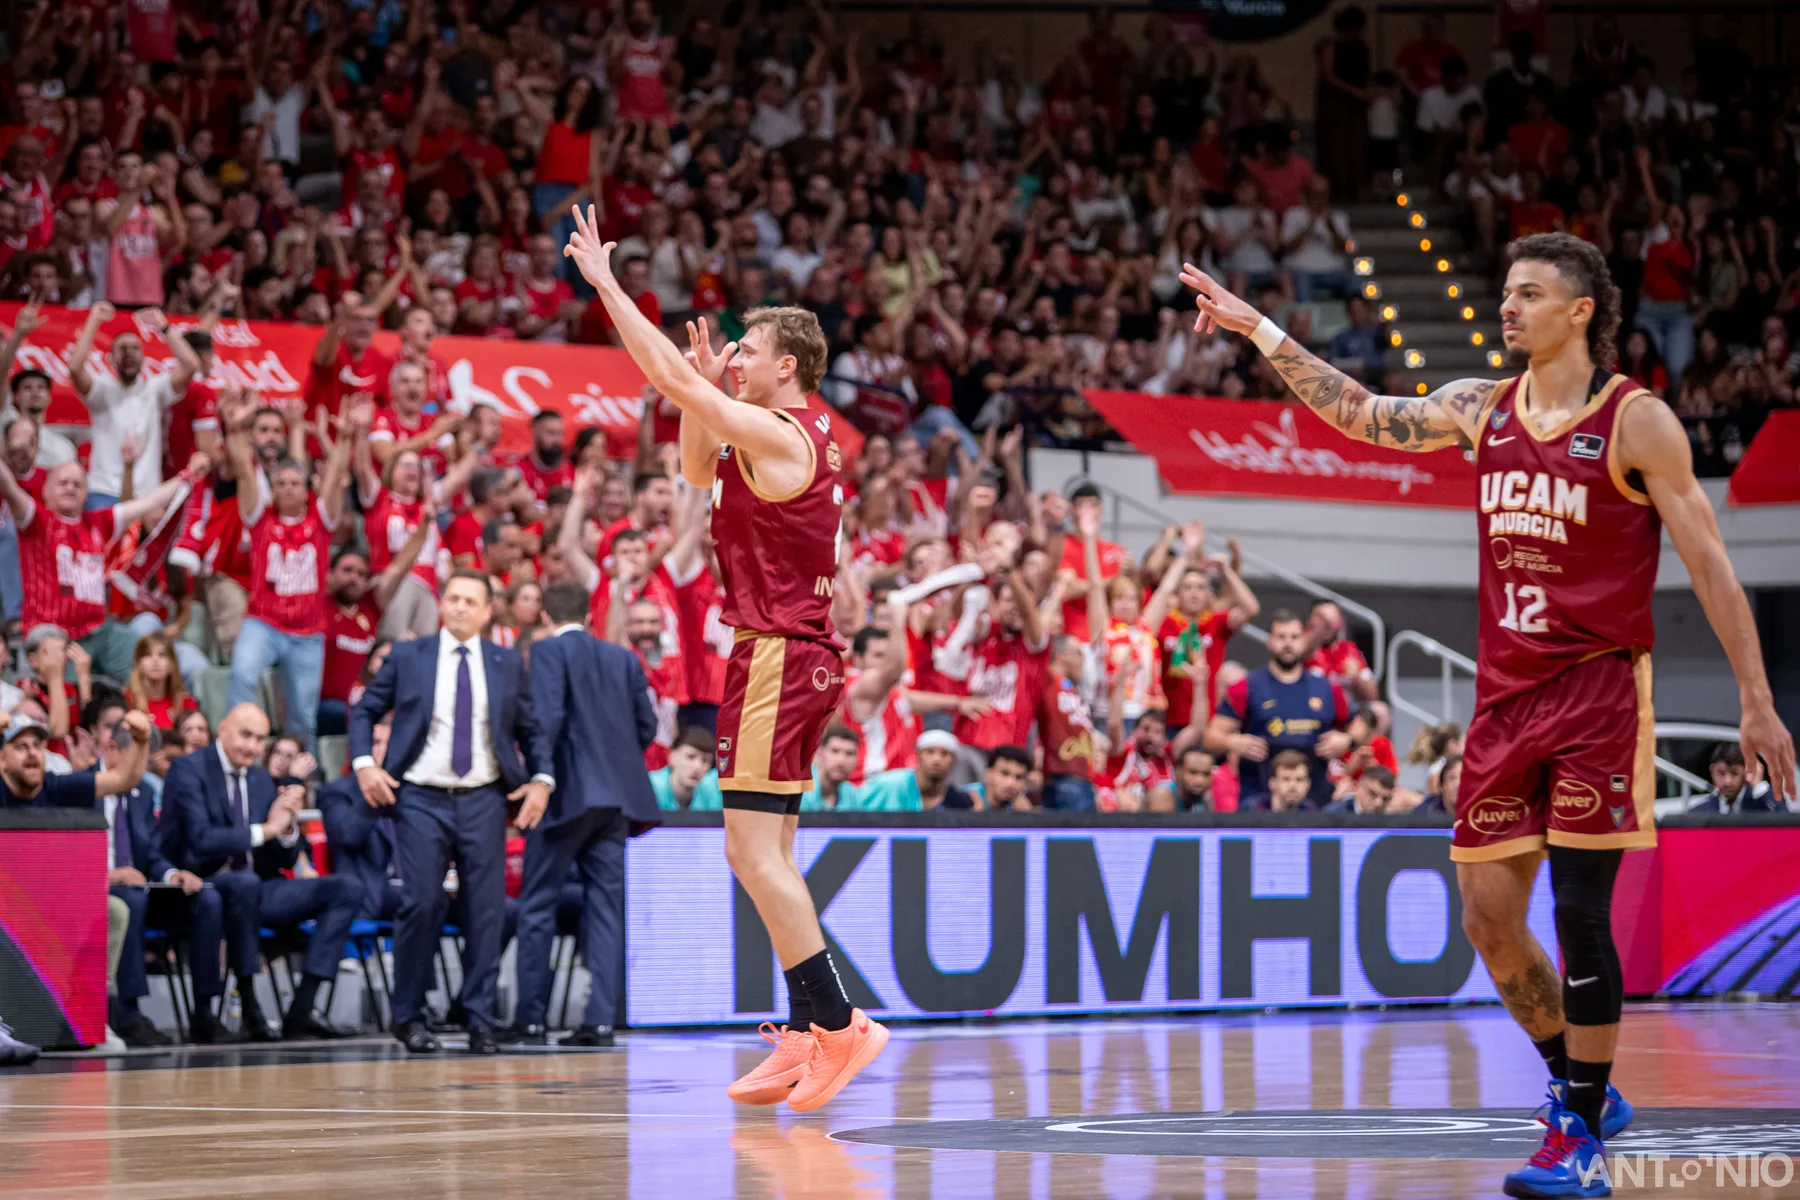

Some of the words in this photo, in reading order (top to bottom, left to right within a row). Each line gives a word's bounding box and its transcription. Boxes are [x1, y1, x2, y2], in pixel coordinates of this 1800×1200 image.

[1480, 470, 1588, 526] UCAM
[1488, 512, 1568, 544] MURCIA
[1498, 582, 1550, 633] 12
[1474, 808, 1523, 824] Juver
[732, 833, 1477, 1013] KUMHO
